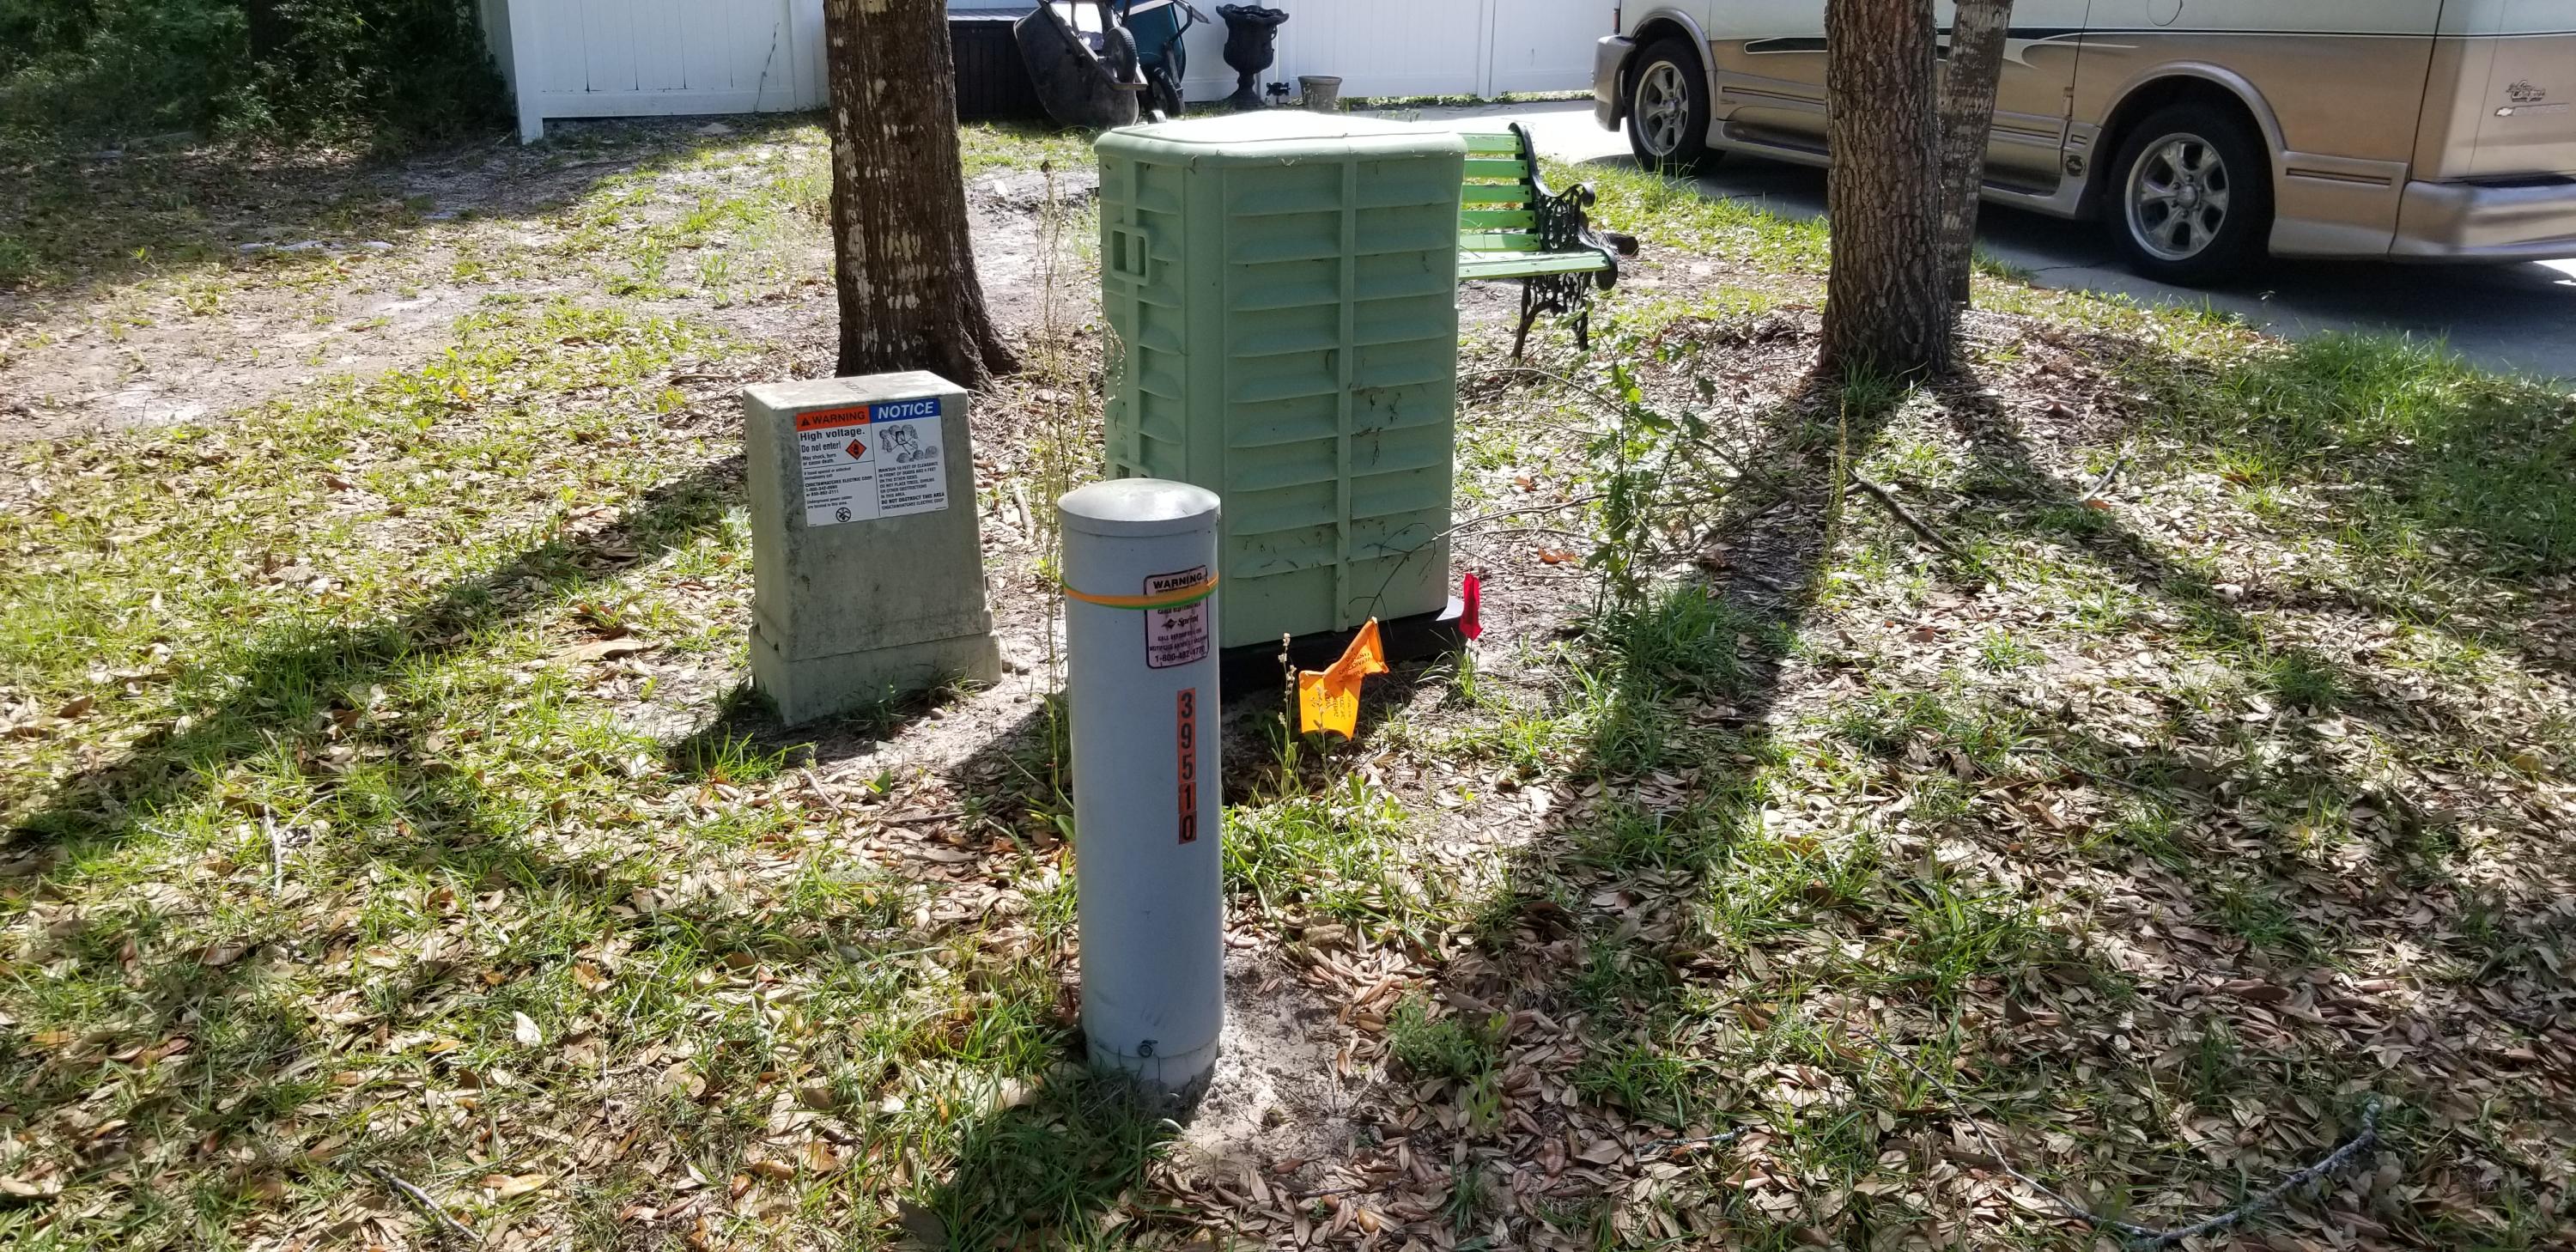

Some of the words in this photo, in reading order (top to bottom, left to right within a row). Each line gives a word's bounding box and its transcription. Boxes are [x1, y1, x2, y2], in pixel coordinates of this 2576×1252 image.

[878, 401, 934, 419] NOTICE
[812, 411, 865, 424] WARNING
[800, 431, 822, 441] High
[826, 428, 865, 438] voltage.
[811, 443, 821, 451] not
[823, 441, 841, 450] enter!
[1153, 573, 1202, 589] WARNING
[1178, 614, 1198, 627] Sprint
[1181, 692, 1194, 841] 39510
